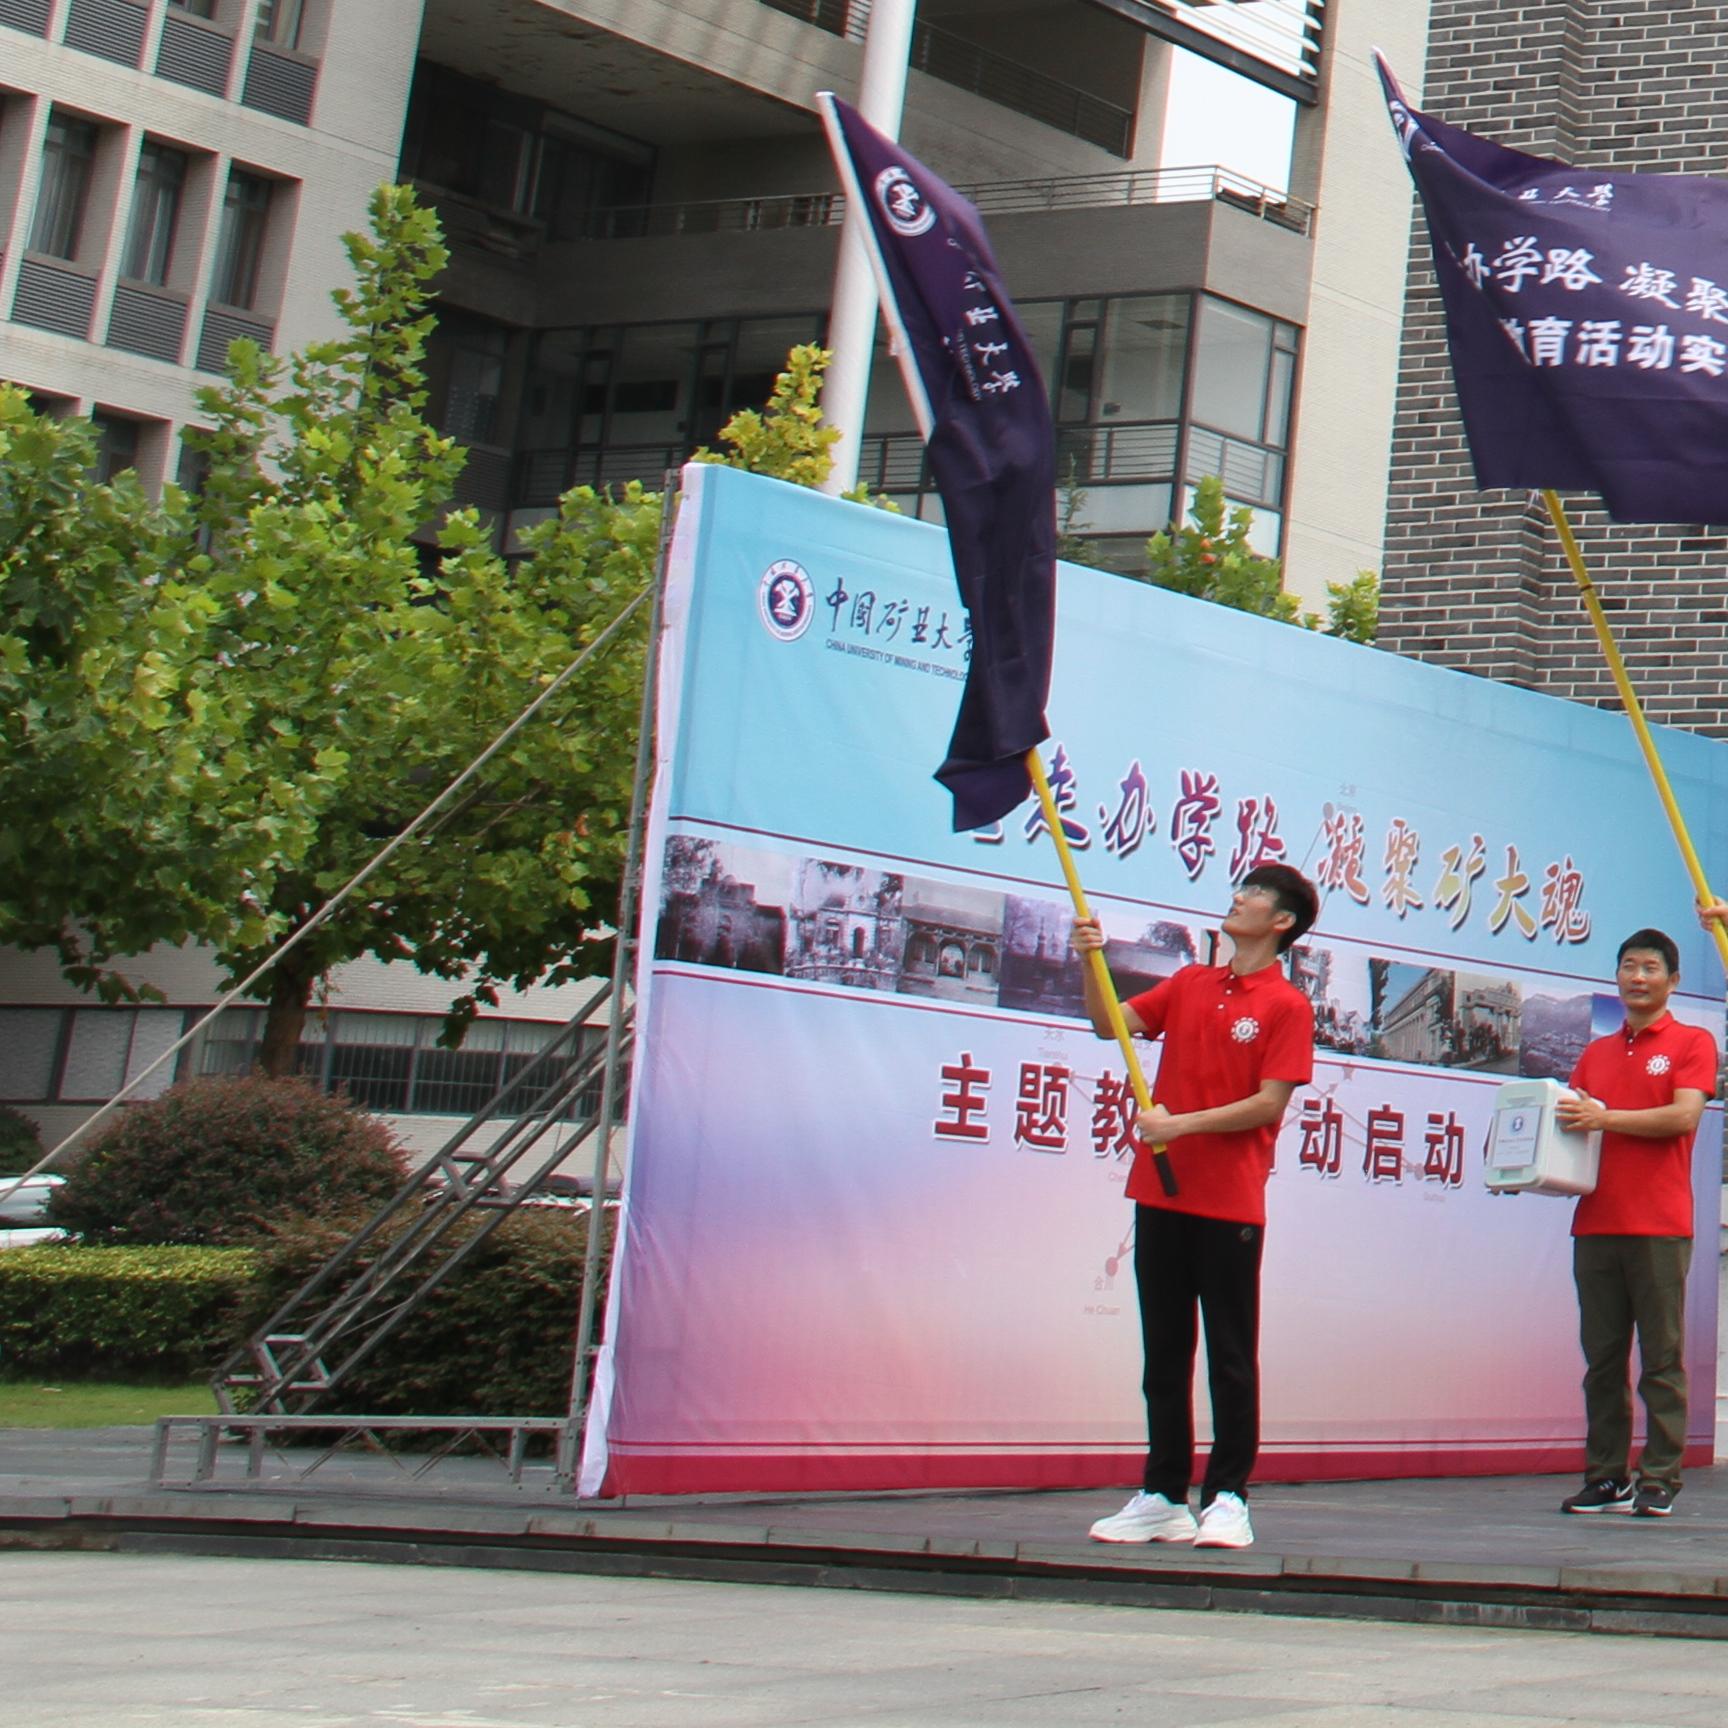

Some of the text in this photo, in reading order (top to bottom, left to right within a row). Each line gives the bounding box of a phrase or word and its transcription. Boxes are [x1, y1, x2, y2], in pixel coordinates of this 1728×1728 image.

[1445, 235, 1603, 294] 办学路
[826, 638, 846, 652] CHINA
[846, 643, 884, 662] UNIVERSITY
[894, 655, 917, 671] MINING
[971, 742, 1287, 884] 走办学路
